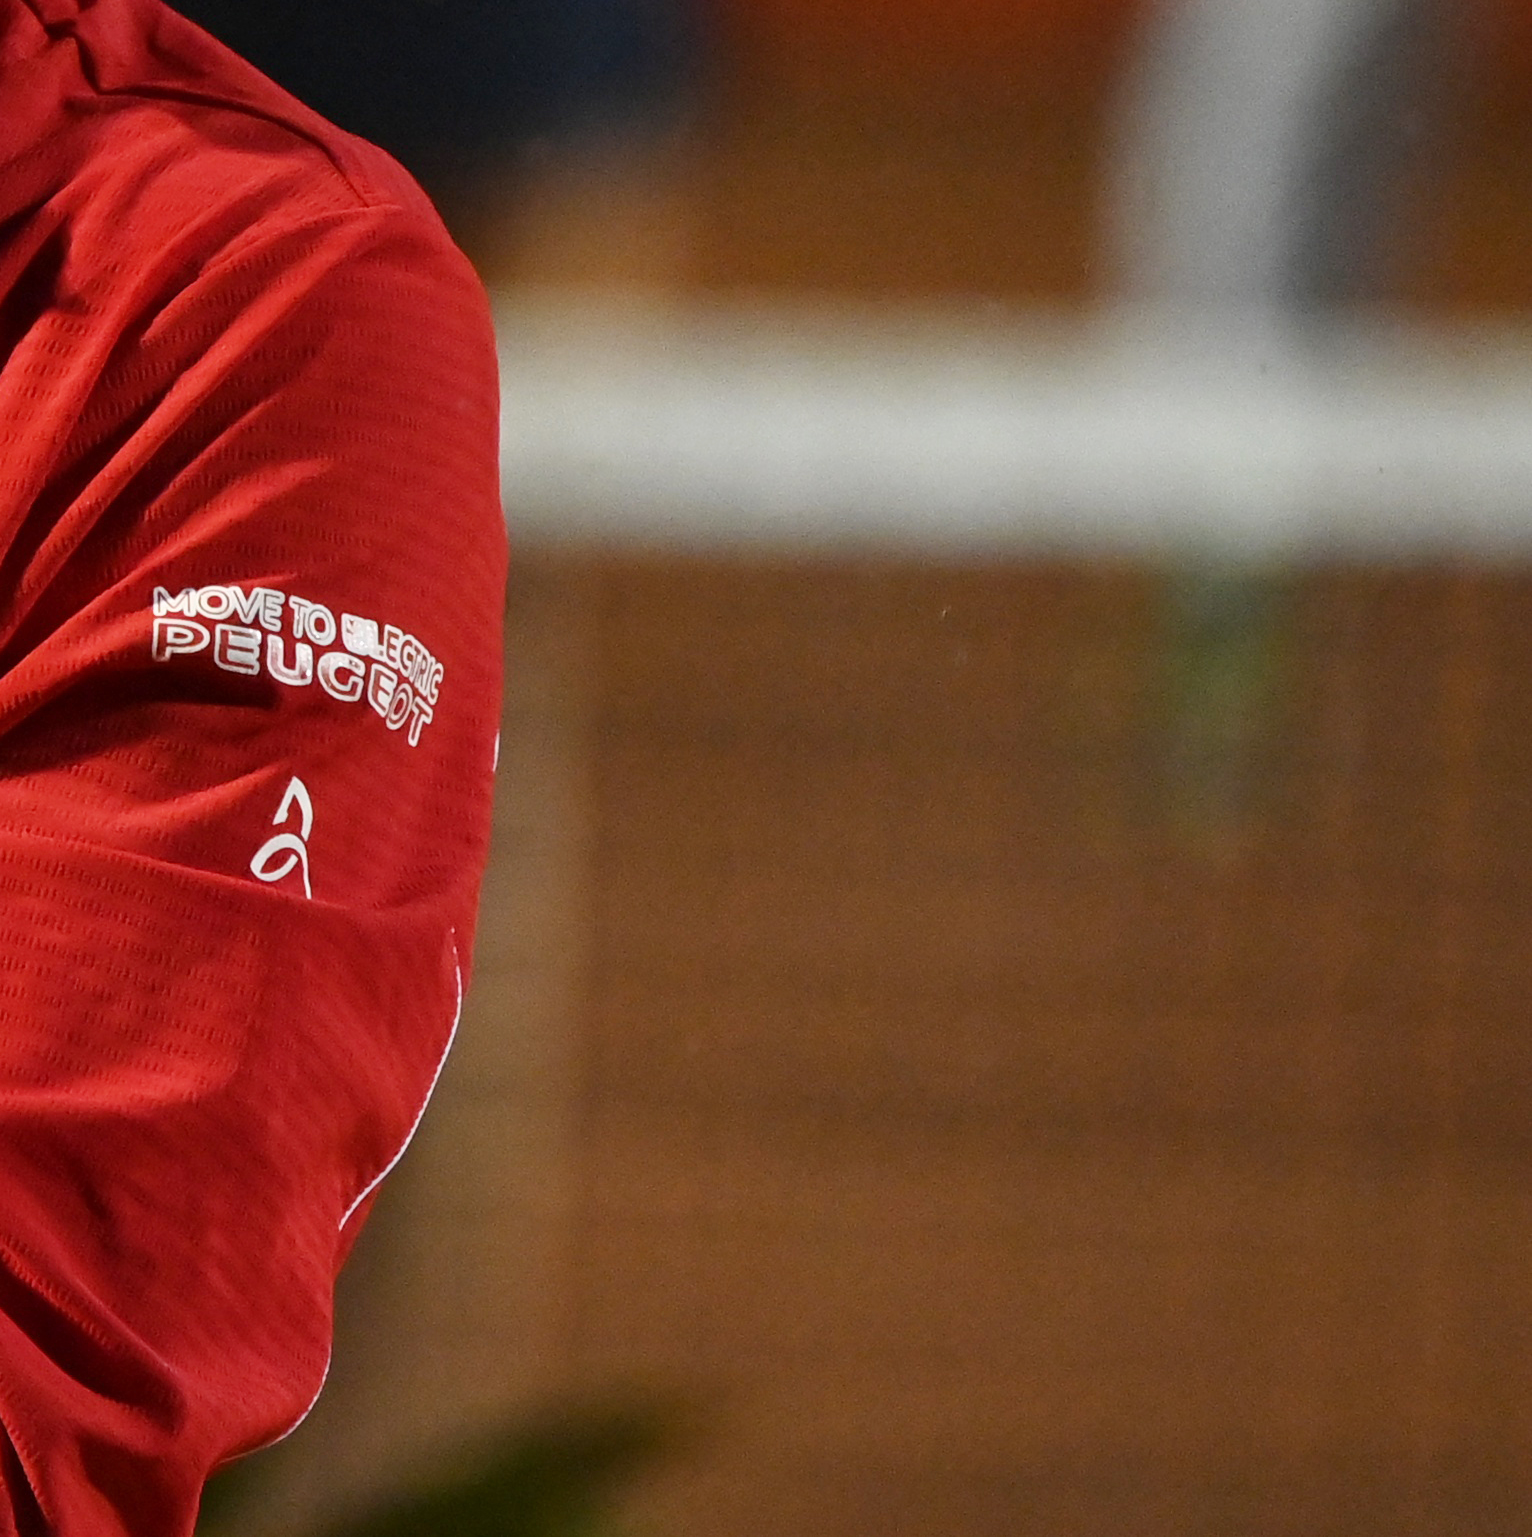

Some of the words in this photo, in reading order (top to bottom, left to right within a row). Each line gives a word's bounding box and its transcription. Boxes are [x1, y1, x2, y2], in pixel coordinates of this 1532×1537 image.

[153, 585, 285, 631] MOVE
[288, 596, 336, 645] TO
[152, 618, 433, 747] PEUGEOT
